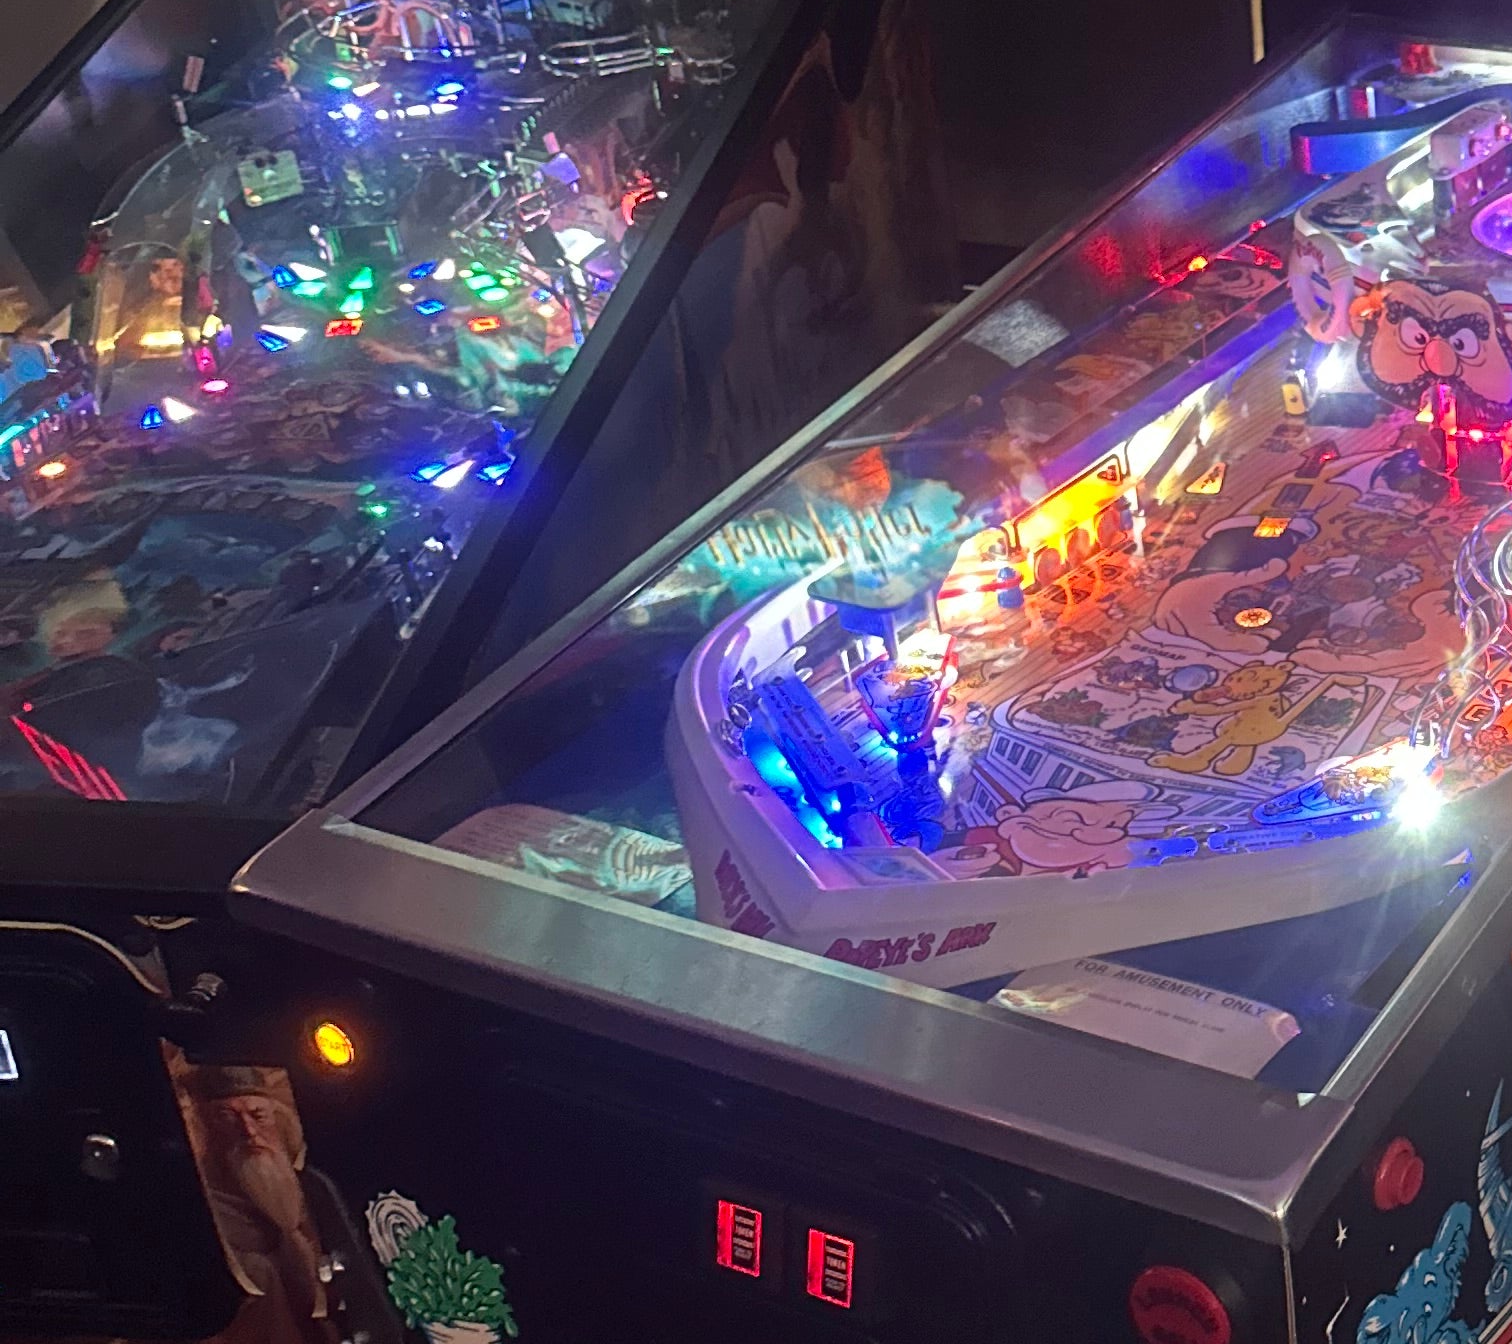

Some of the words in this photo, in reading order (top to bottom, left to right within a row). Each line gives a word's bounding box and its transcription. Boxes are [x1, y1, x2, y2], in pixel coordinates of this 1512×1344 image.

[935, 921, 998, 957] ARK
[1074, 959, 1109, 974] FOR
[1113, 968, 1215, 1002] AMUSEMENT
[1221, 995, 1269, 1019] ONLY
